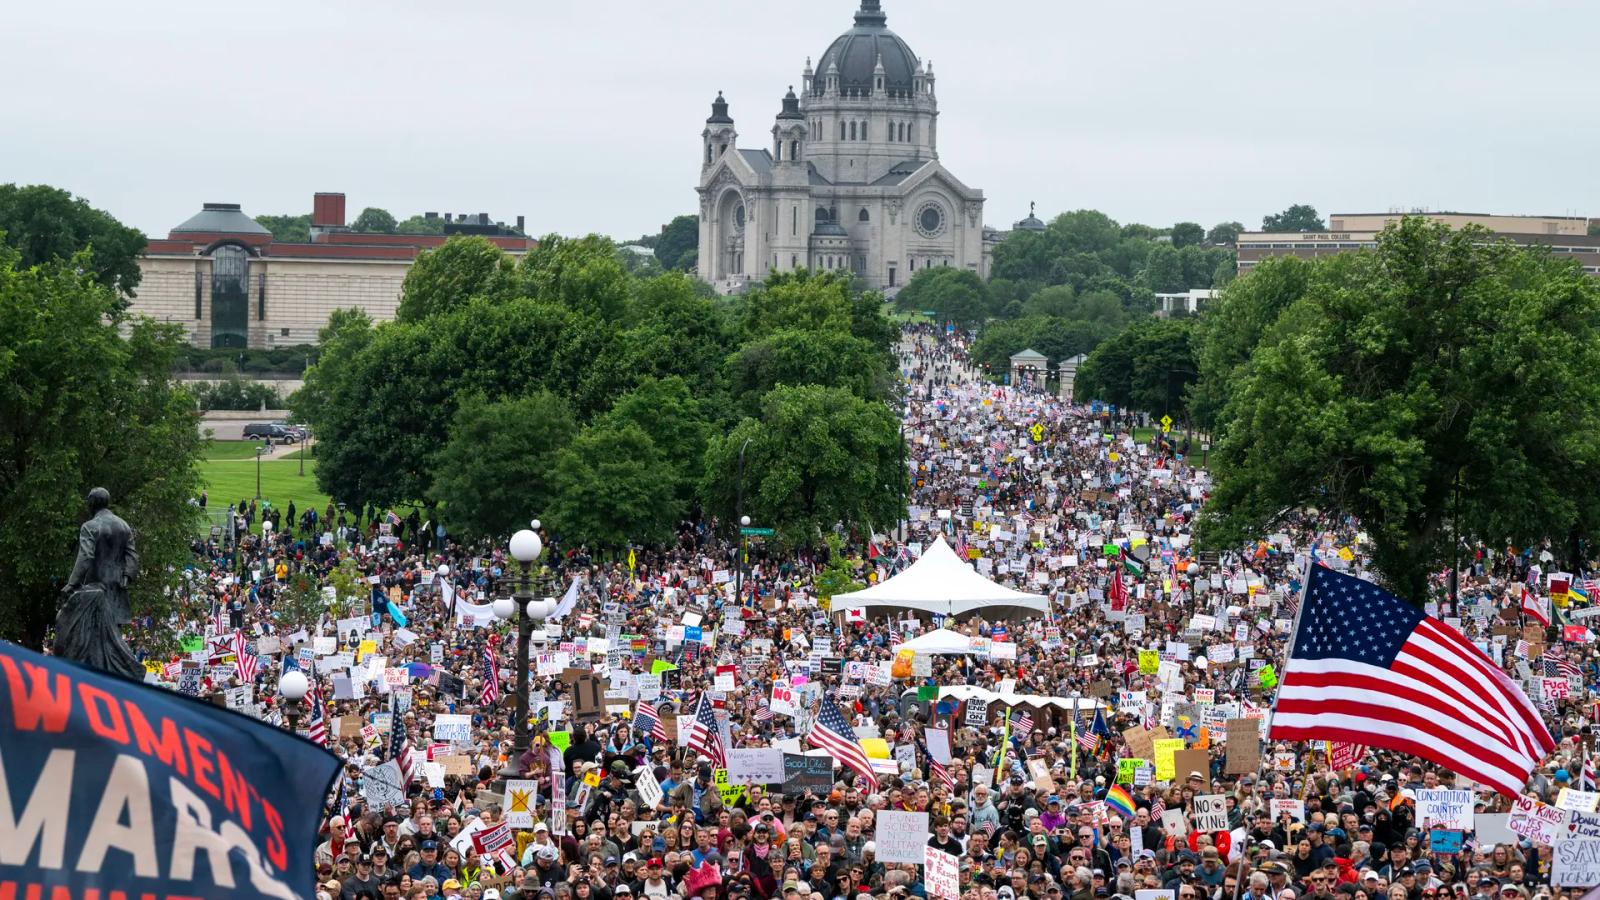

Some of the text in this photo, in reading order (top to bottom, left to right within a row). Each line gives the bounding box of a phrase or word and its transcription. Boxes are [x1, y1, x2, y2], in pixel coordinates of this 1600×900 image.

[1543, 680, 1569, 691] FUCK
[773, 688, 792, 702] NO
[1545, 690, 1568, 699] ICE
[0, 655, 288, 872] WOMEN'S
[784, 757, 808, 768] Good
[1416, 790, 1470, 803] CONSTITUTION
[1195, 799, 1210, 813] NO
[1427, 804, 1463, 815] COUNTRY
[1516, 796, 1532, 811] NO
[889, 814, 919, 823] FUND
[1197, 815, 1226, 830] KING
[1527, 816, 1543, 832] YES
[884, 823, 922, 832] SCIENCE
[1510, 820, 1551, 844] QUEENS
[482, 830, 500, 843] DISSENT
[487, 834, 509, 851] PATRIOTIC
[880, 840, 924, 849] MILITARY
[881, 849, 920, 859] PARADES
[926, 847, 958, 868] So Much
[926, 872, 951, 888] Resist
